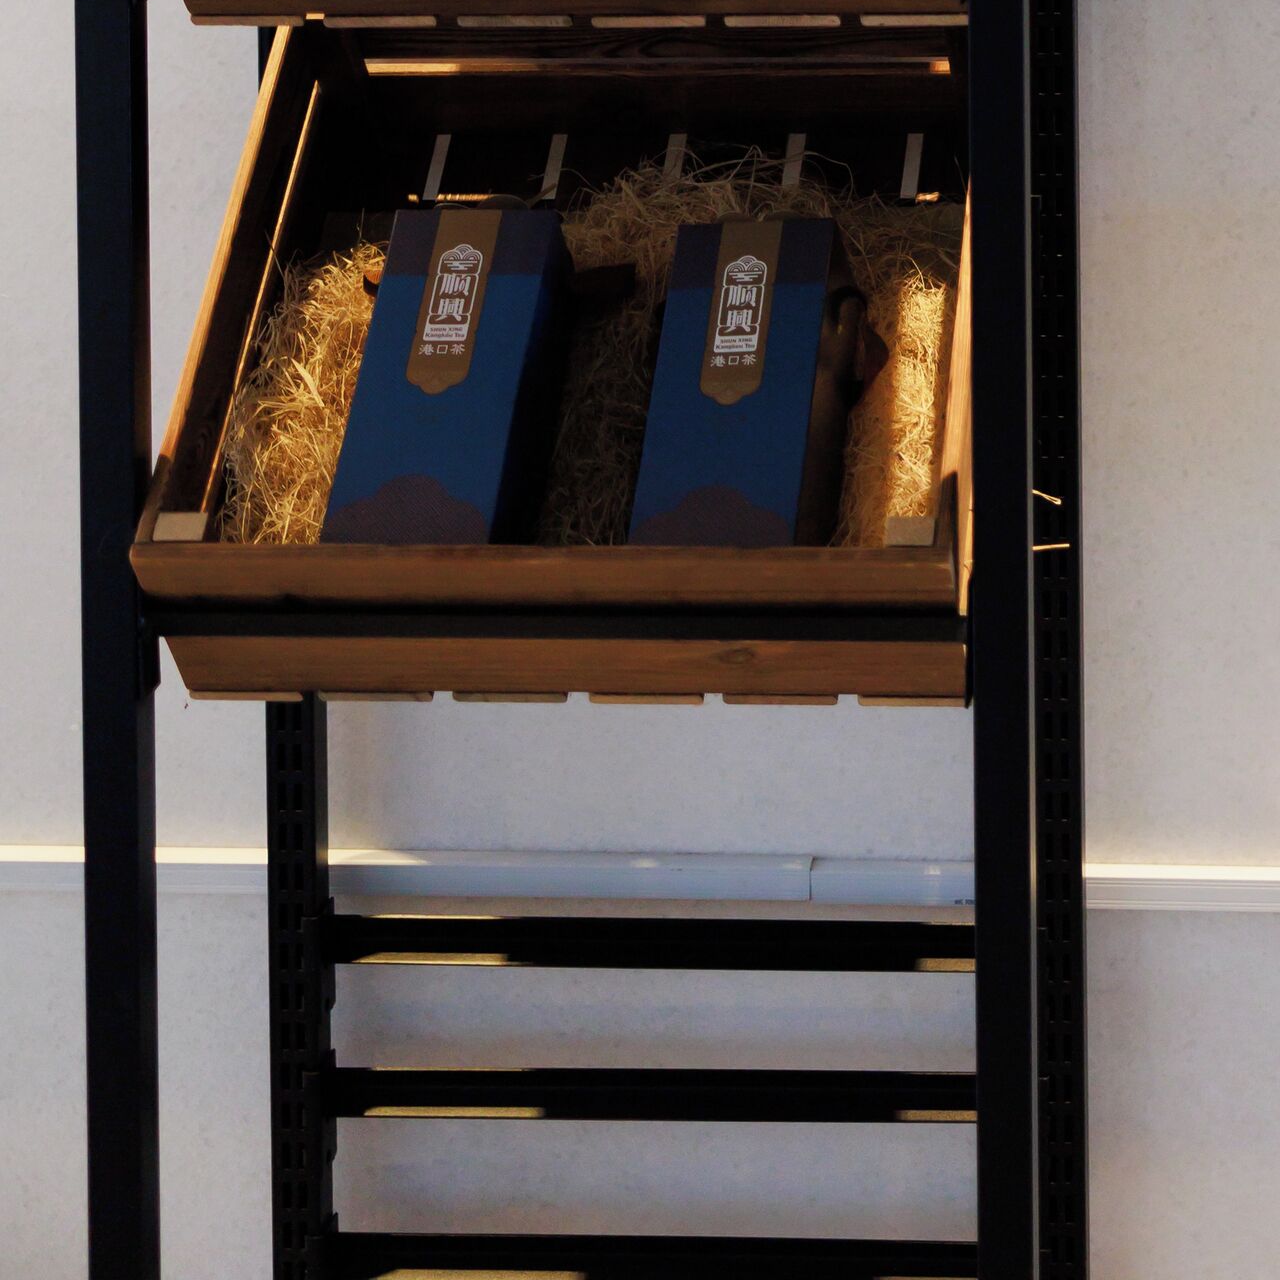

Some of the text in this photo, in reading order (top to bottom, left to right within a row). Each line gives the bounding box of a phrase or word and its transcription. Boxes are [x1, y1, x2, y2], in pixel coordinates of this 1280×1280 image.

[418, 343, 466, 356] 港口茶
[710, 353, 757, 368] 港口茶
